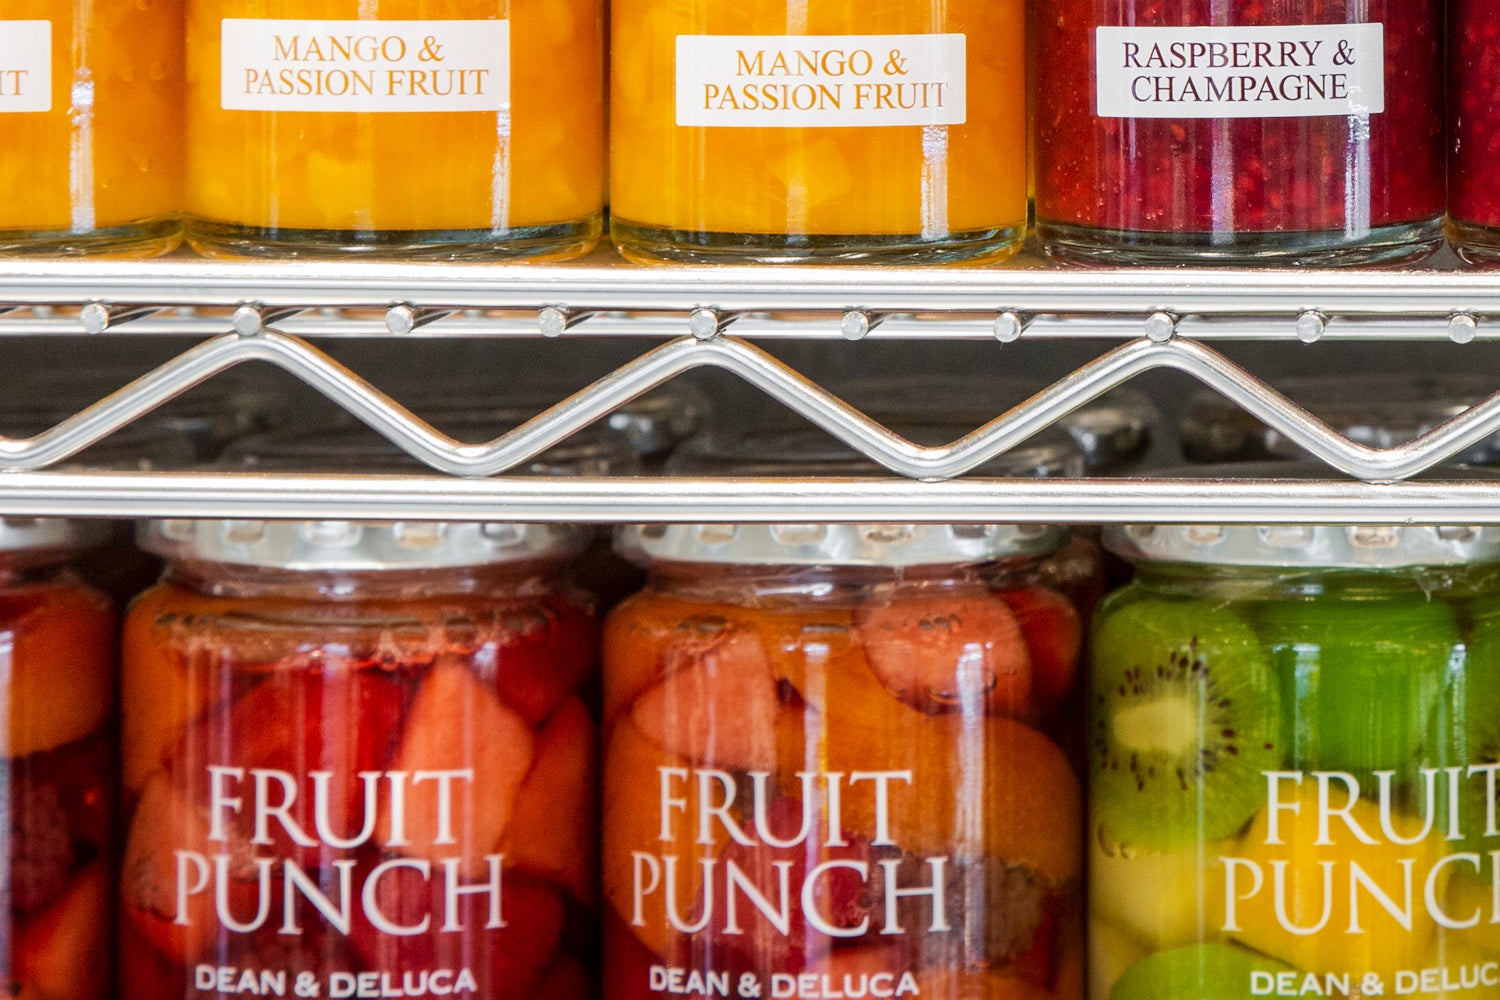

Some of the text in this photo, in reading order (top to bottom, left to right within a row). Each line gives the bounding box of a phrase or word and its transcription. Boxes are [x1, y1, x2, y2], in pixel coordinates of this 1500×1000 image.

[273, 35, 444, 62] MANGO &
[735, 49, 909, 76] MANGO &
[1123, 39, 1355, 68] RASPBERRY &
[244, 68, 489, 96] PASSION FRUIT
[703, 83, 949, 110] PASSION FRUIT
[1132, 74, 1348, 102] CHAMPAGNE
[207, 766, 473, 849] FRUIT
[658, 767, 912, 848] FRUIT
[174, 850, 506, 936] PUNCH
[632, 852, 951, 937] PUNCH
[196, 964, 477, 998] DEAN & DELUCA
[650, 966, 919, 999] DEAN & DELUCA
[1251, 971, 1349, 996] DEAN
[1361, 971, 1384, 996] &
